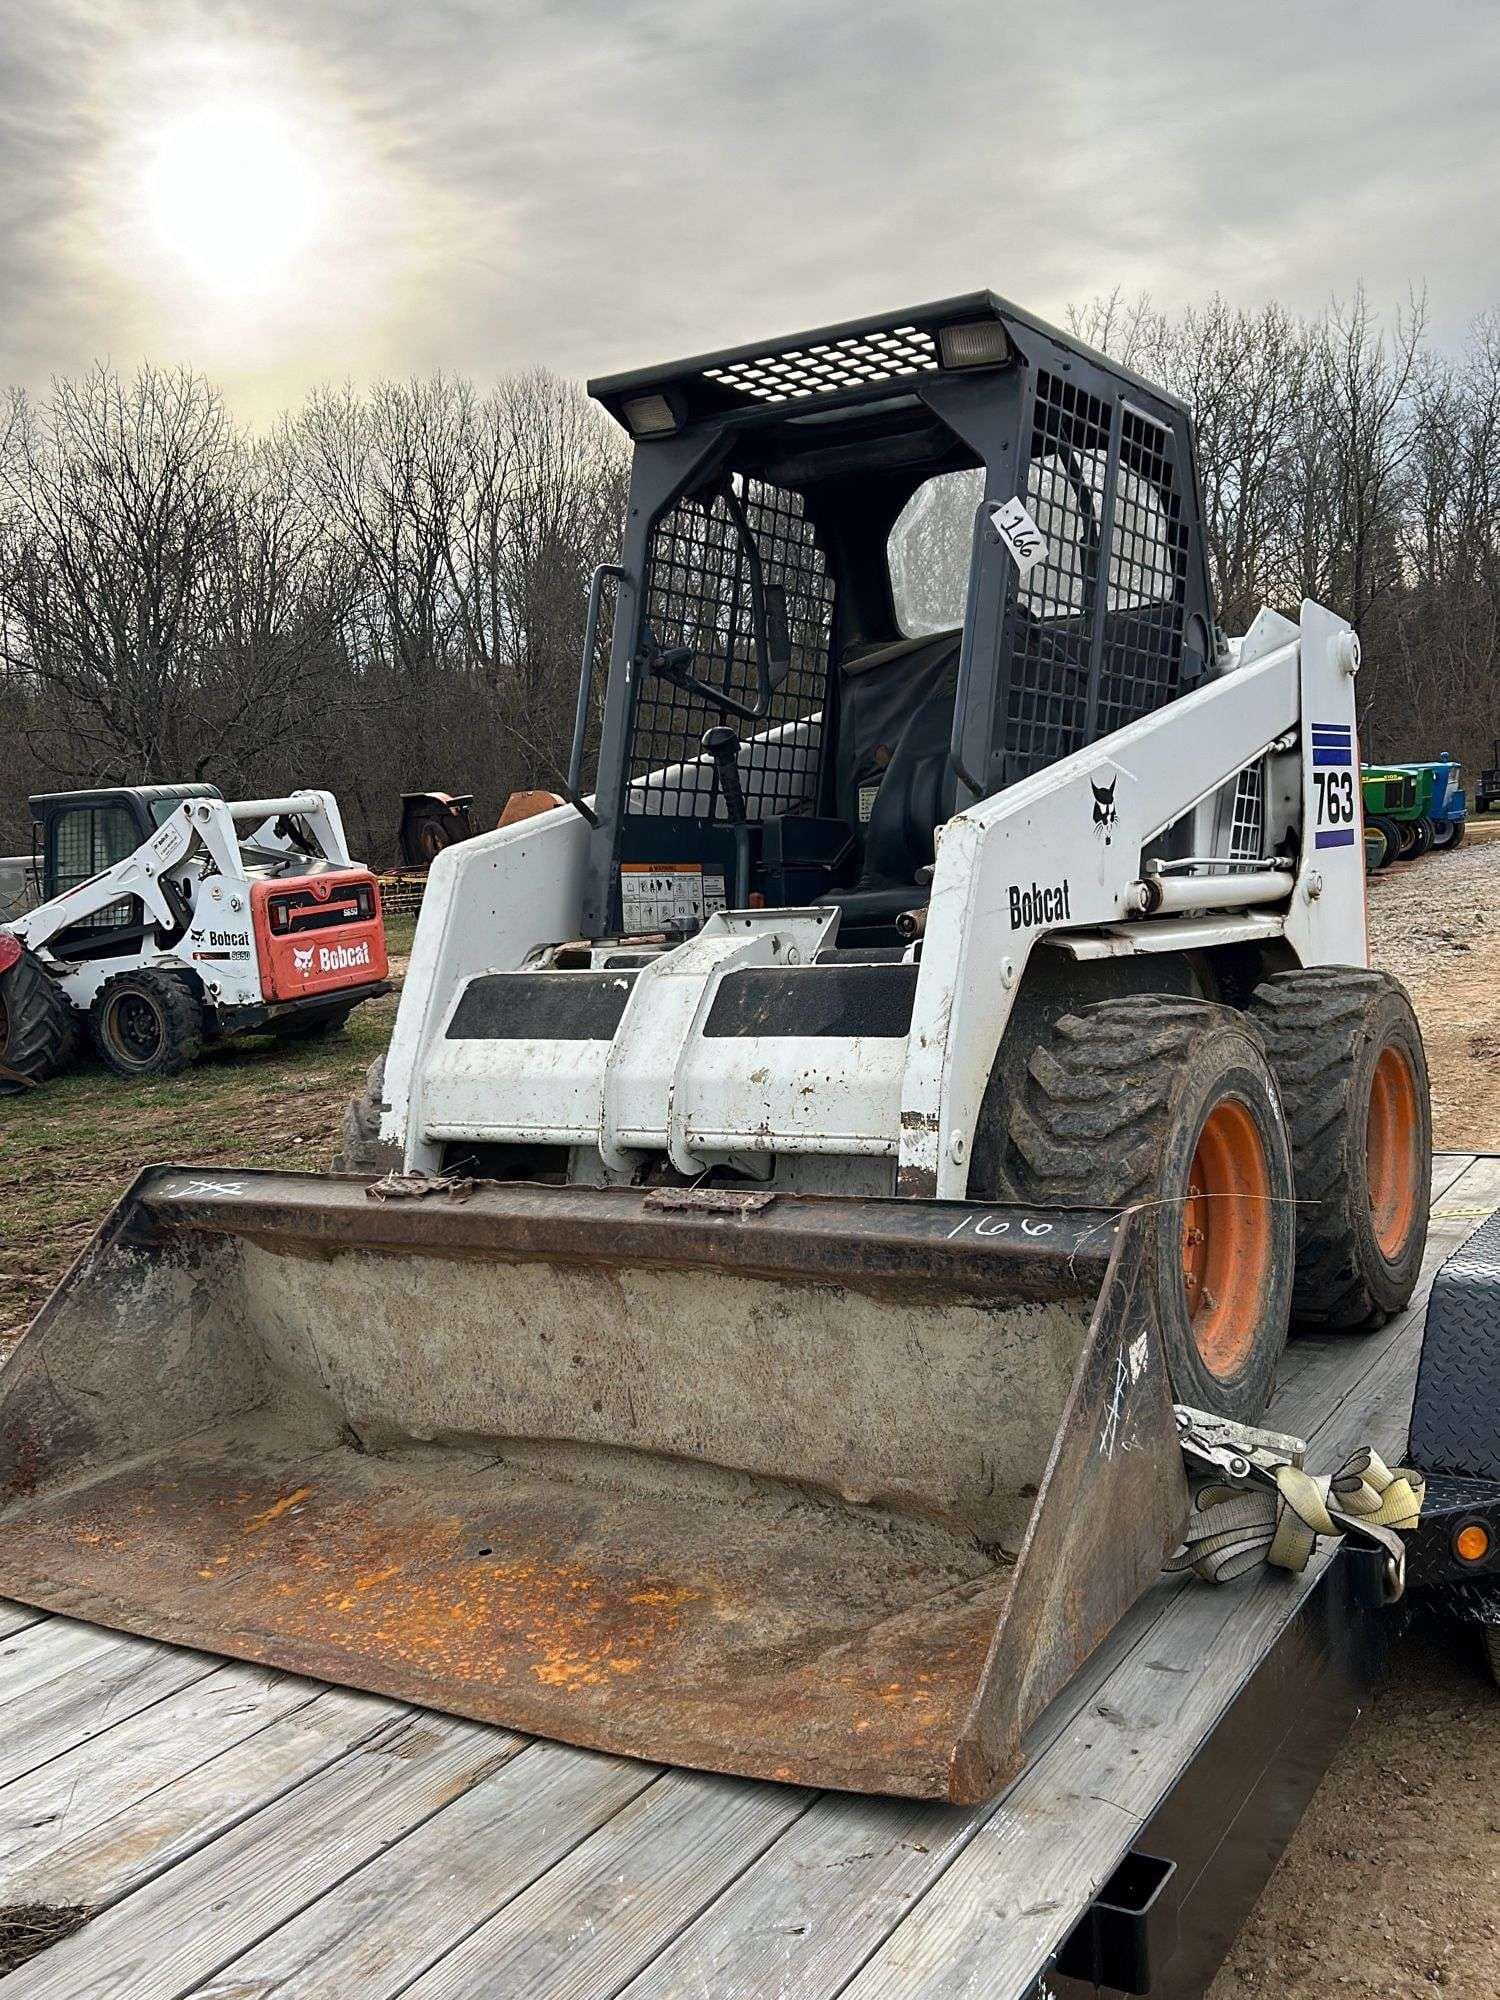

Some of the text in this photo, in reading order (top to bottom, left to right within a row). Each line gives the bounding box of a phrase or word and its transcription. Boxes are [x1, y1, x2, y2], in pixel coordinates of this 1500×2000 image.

[1000, 516, 1041, 558] 166
[1313, 772, 1354, 825] 763
[343, 907, 358, 917] S650
[1009, 879, 1070, 930] Bobcat
[209, 930, 250, 946] Bobcat
[231, 951, 250, 960] S650
[319, 941, 369, 971] Bobcat
[947, 1215, 1053, 1239] 166
